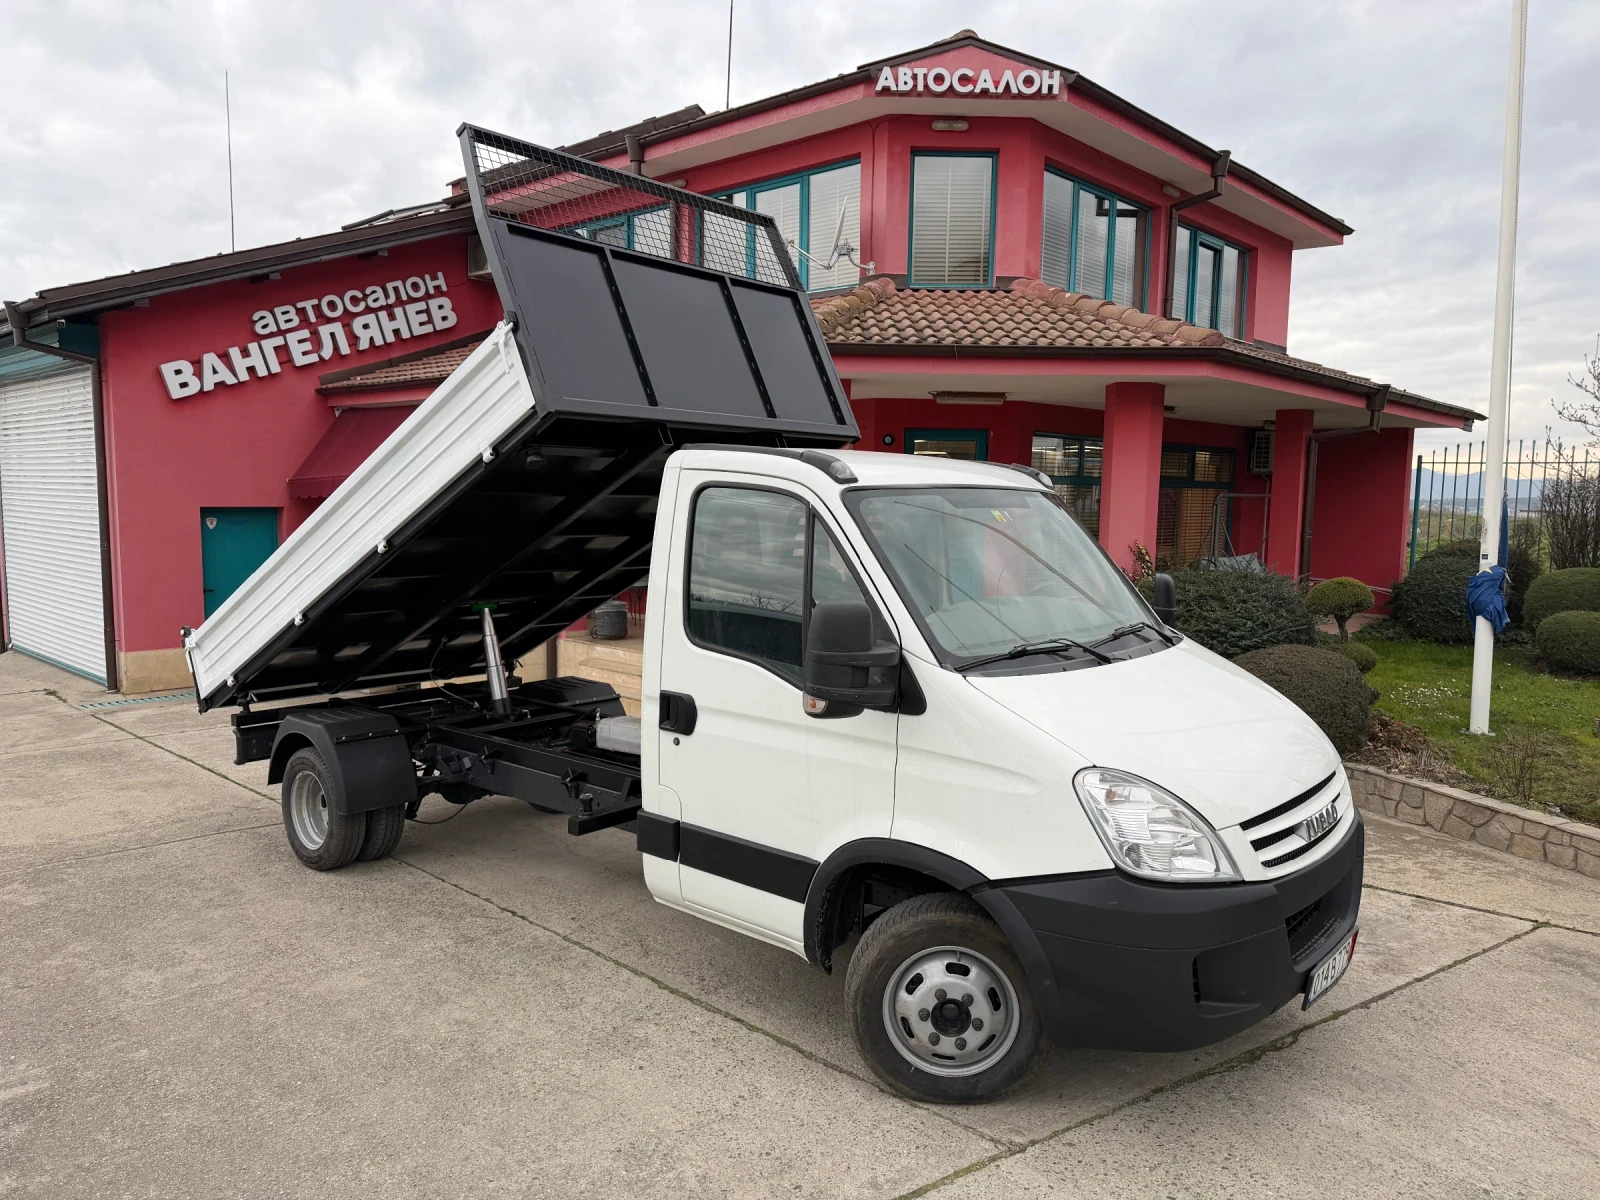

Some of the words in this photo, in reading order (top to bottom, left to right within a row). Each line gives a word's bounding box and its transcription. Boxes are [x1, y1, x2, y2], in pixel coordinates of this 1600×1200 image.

[875, 66, 1061, 96] АВТОСАЛОН
[252, 271, 448, 335] автосалон
[159, 321, 351, 400] ВАНГЕЛ
[351, 296, 458, 351] ЯНЕВ
